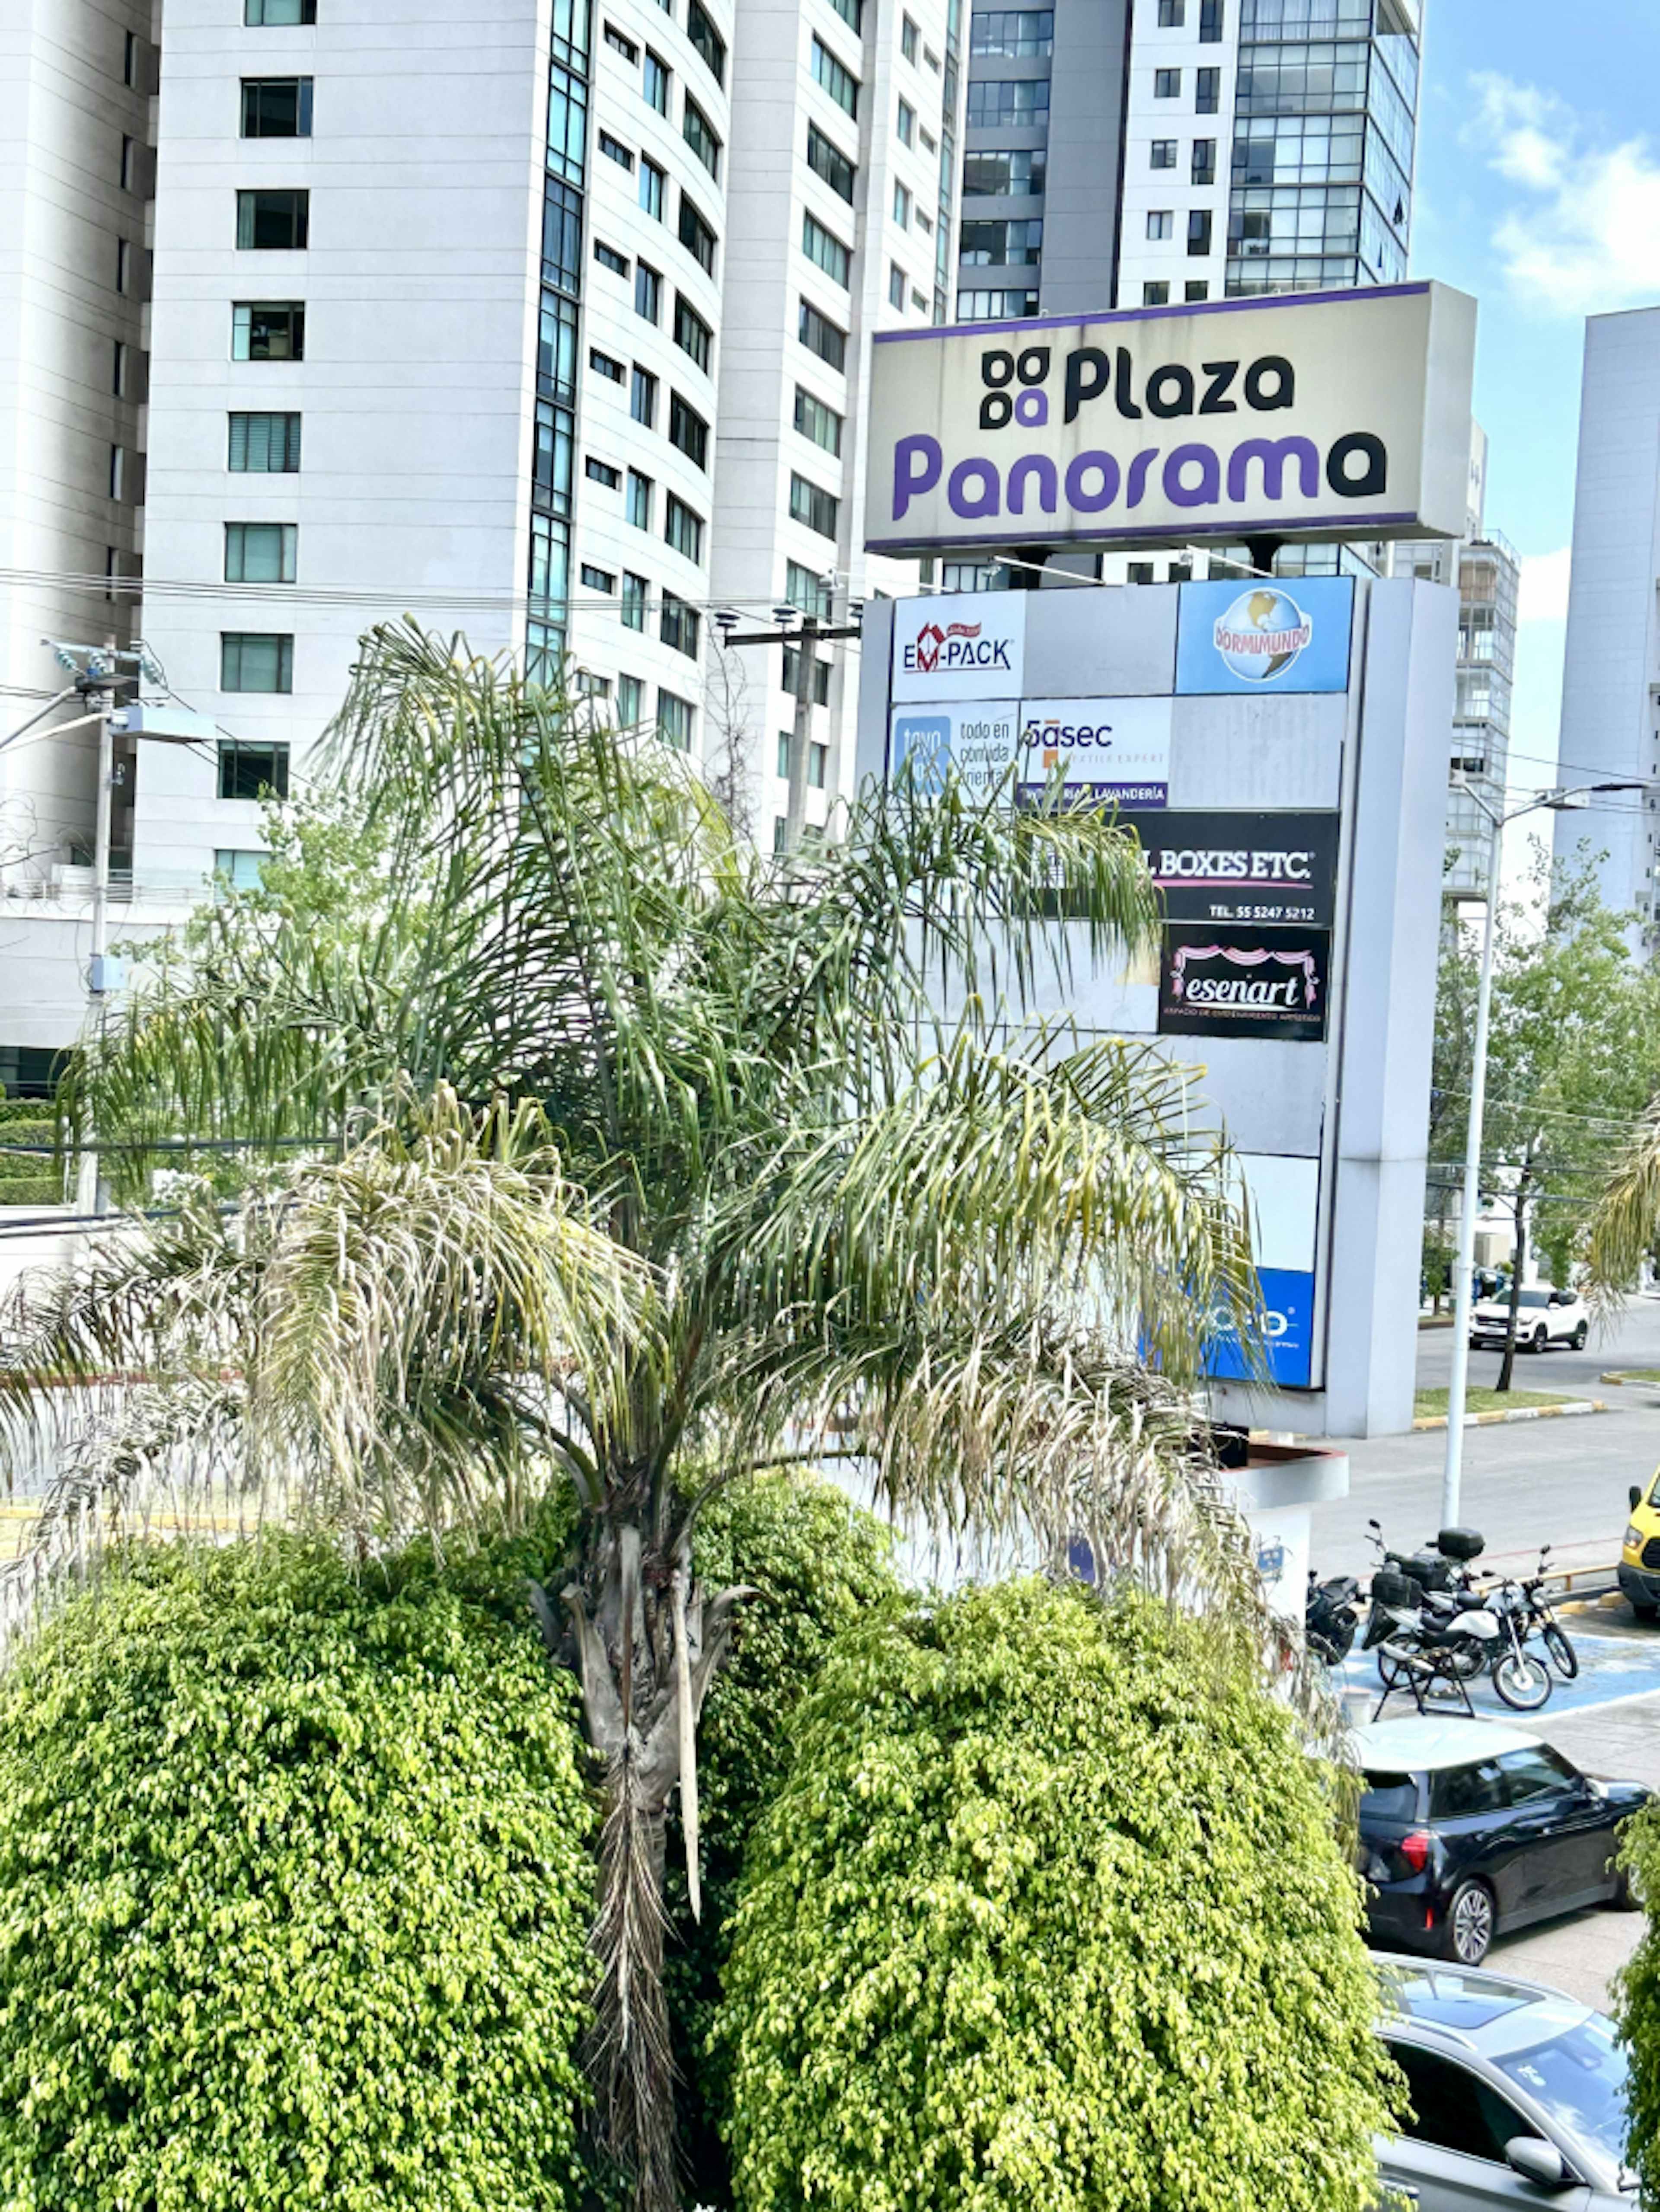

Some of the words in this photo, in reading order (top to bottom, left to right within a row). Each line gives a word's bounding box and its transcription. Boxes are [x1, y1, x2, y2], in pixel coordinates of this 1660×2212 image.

[1064, 347, 1295, 425] Plaza
[893, 432, 1387, 521] Panorama
[1216, 625, 1309, 654] DORMIMUNDO
[961, 721, 990, 739] todo
[994, 723, 1009, 738] en
[1067, 754, 1112, 764] EXTILE
[1159, 849, 1248, 878] BOXES
[1250, 851, 1311, 879] ETC.
[1209, 904, 1232, 918] TEL.
[1236, 905, 1252, 918] 55
[1253, 906, 1283, 919] 5247
[1285, 907, 1315, 920] 5212
[1186, 977, 1299, 1006] esenart
